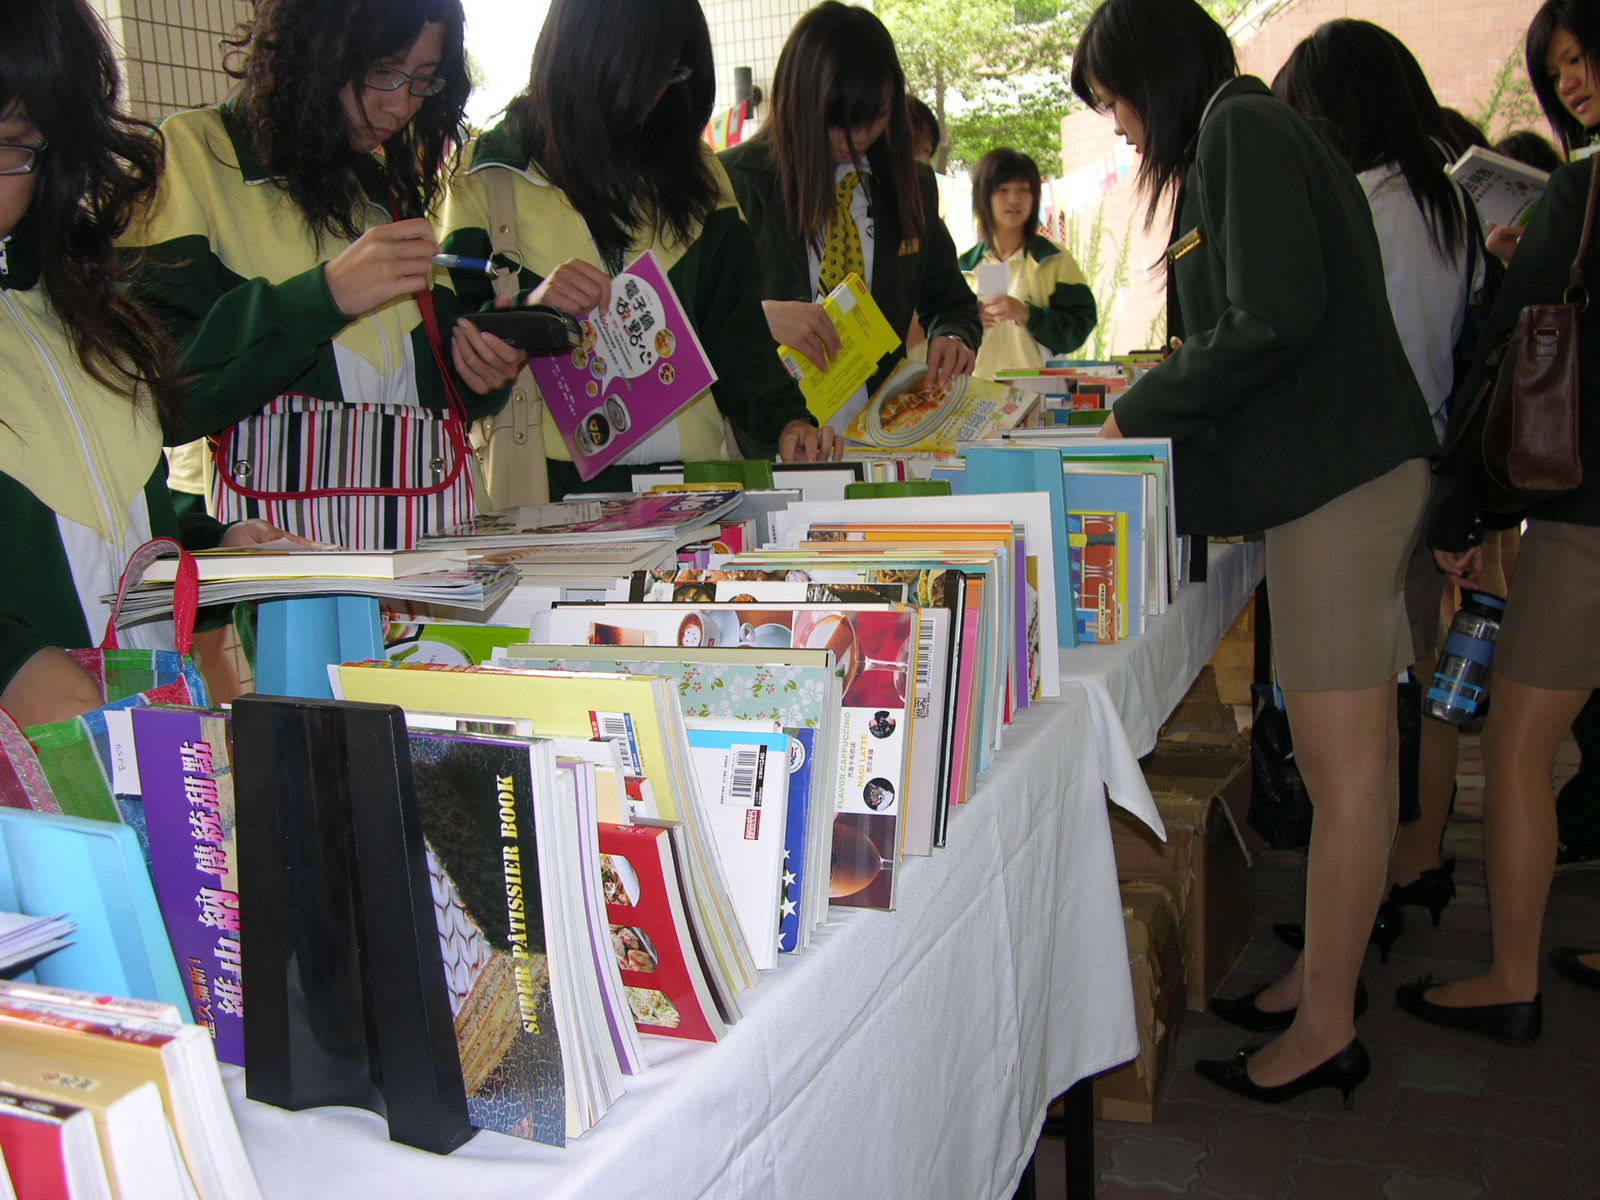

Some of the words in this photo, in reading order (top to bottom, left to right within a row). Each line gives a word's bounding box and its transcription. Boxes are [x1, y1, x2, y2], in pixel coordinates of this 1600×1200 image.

[615, 296, 653, 366] 做點心
[624, 279, 656, 332] 電子鍋
[840, 712, 851, 765] CAPPUCCINO
[860, 733, 869, 761] LATTE
[837, 767, 846, 810] FLAVOR
[857, 763, 867, 788] NAGI
[179, 740, 229, 876] 傳統甜點
[496, 774, 519, 840] BOOK
[502, 845, 528, 961] PÂTISSIER
[515, 965, 540, 1035] SUPER
